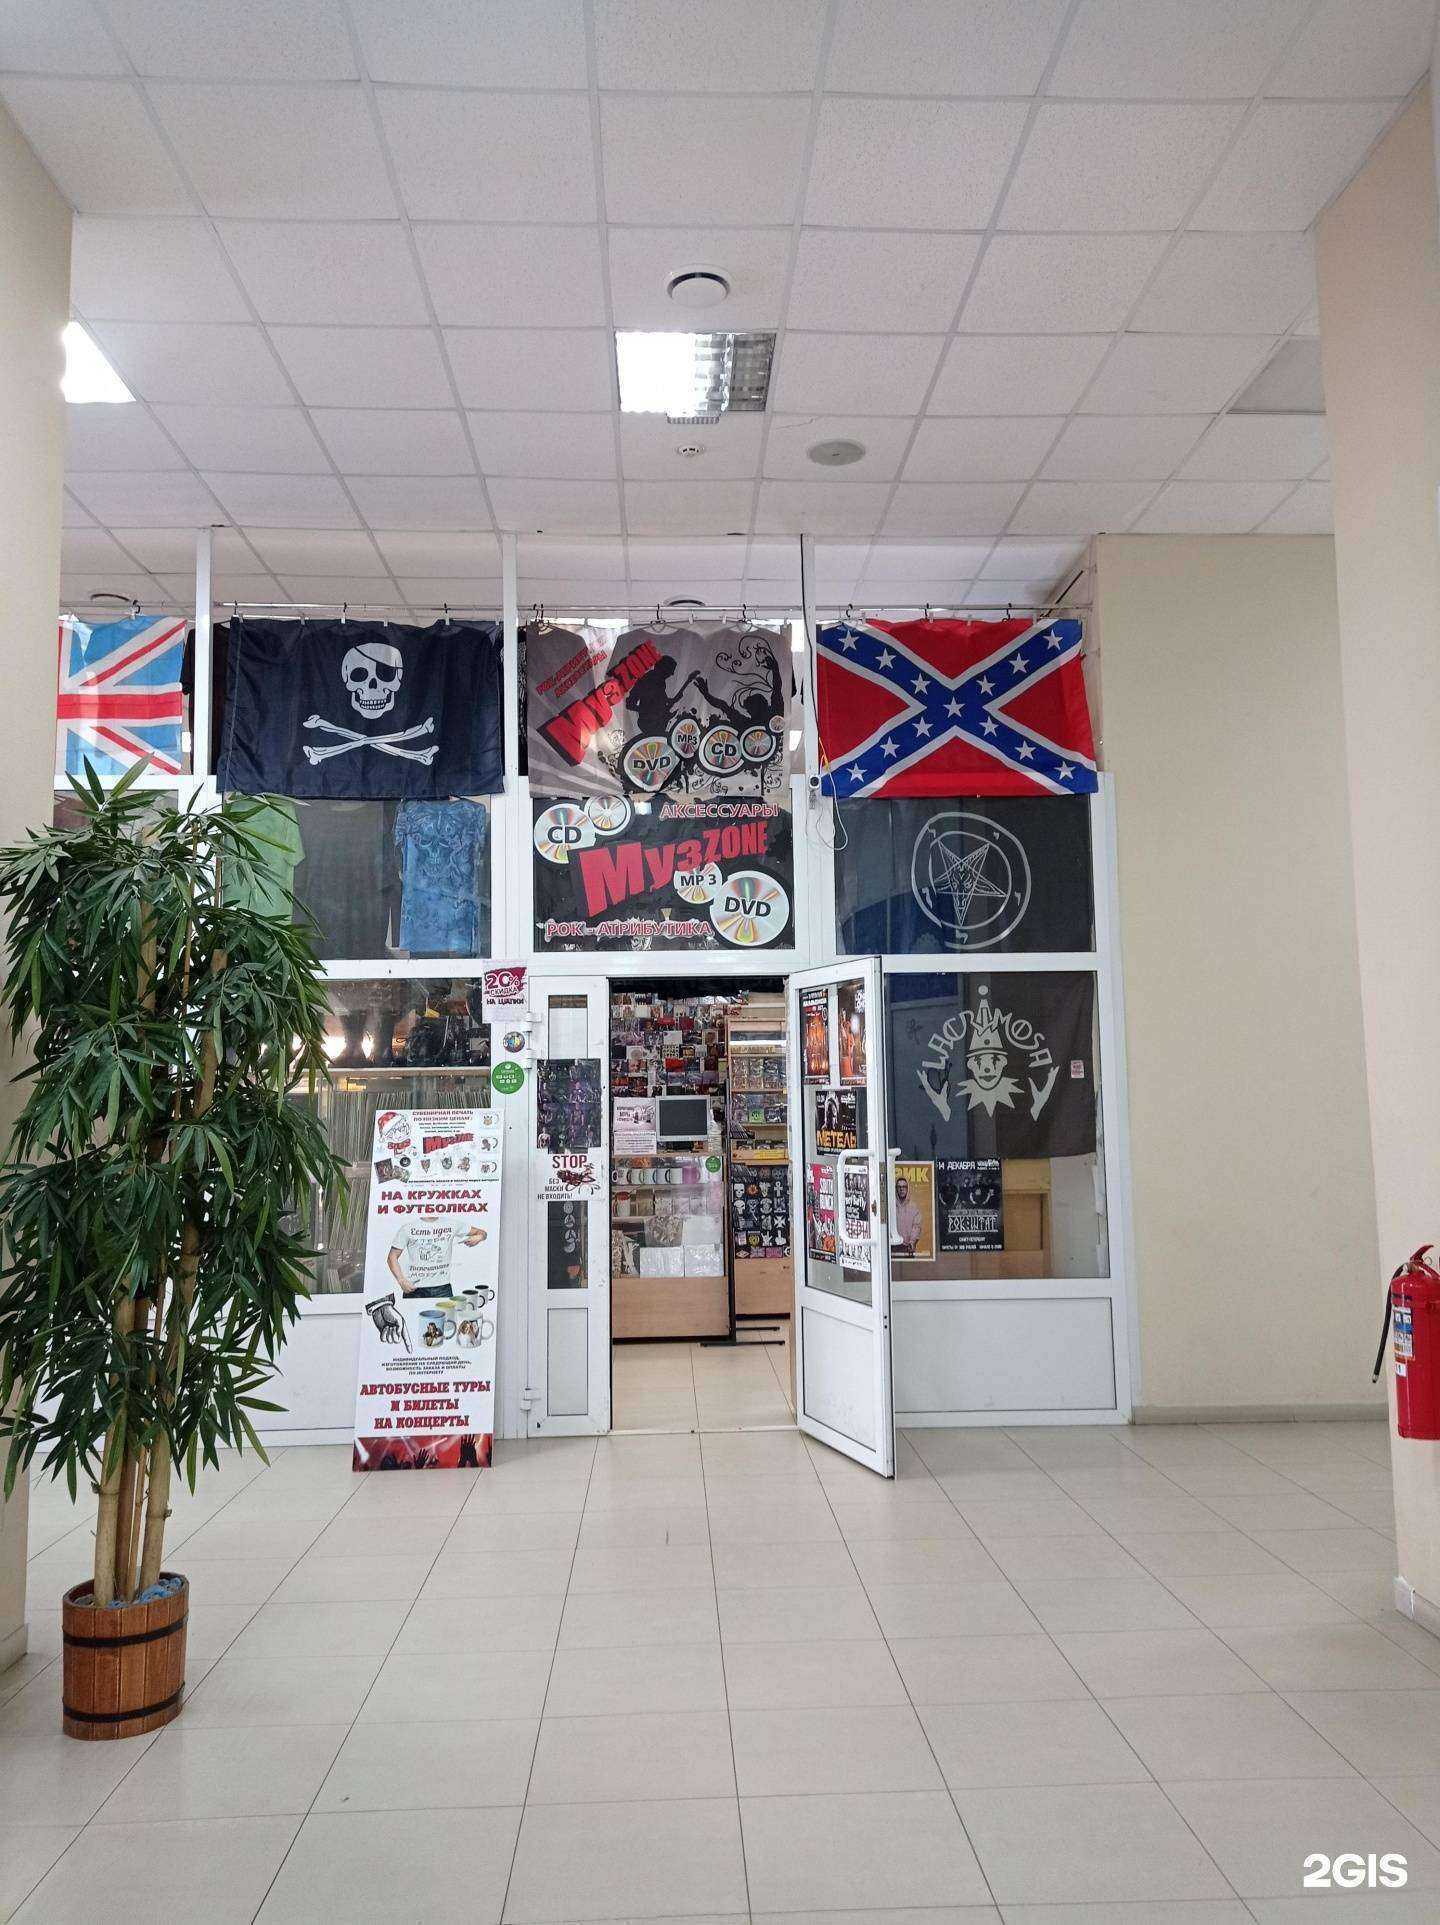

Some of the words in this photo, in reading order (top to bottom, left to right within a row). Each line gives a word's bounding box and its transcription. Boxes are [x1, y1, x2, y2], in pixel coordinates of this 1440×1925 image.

[677, 734, 698, 745] MP3
[711, 743, 737, 757] CD
[633, 756, 671, 771] DVD
[660, 803, 778, 818] АКСЕССУАРЫ
[547, 826, 582, 844] CD
[724, 896, 772, 917] DVD
[547, 922, 583, 936] РОК
[598, 921, 712, 936] АТРИБУТИКА
[486, 972, 520, 990] 20%
[490, 986, 519, 996] СКИДКА
[552, 1155, 587, 1168] STOP
[947, 1161, 975, 1170] ДЕКАБРЯ
[381, 1191, 403, 1200] НА
[407, 1189, 482, 1200] КРУЖКАХ
[377, 1205, 388, 1214] И
[393, 1202, 488, 1214] ФУТБОЛКАХ
[360, 1382, 449, 1395] АВТОБУСНЫЕ
[453, 1381, 491, 1392] ТУРЫ
[390, 1400, 400, 1411] И
[404, 1399, 459, 1411] БИЛЕТЫ
[374, 1418, 393, 1429] НА
[396, 1415, 469, 1429] КОНЦЕРТЫ
